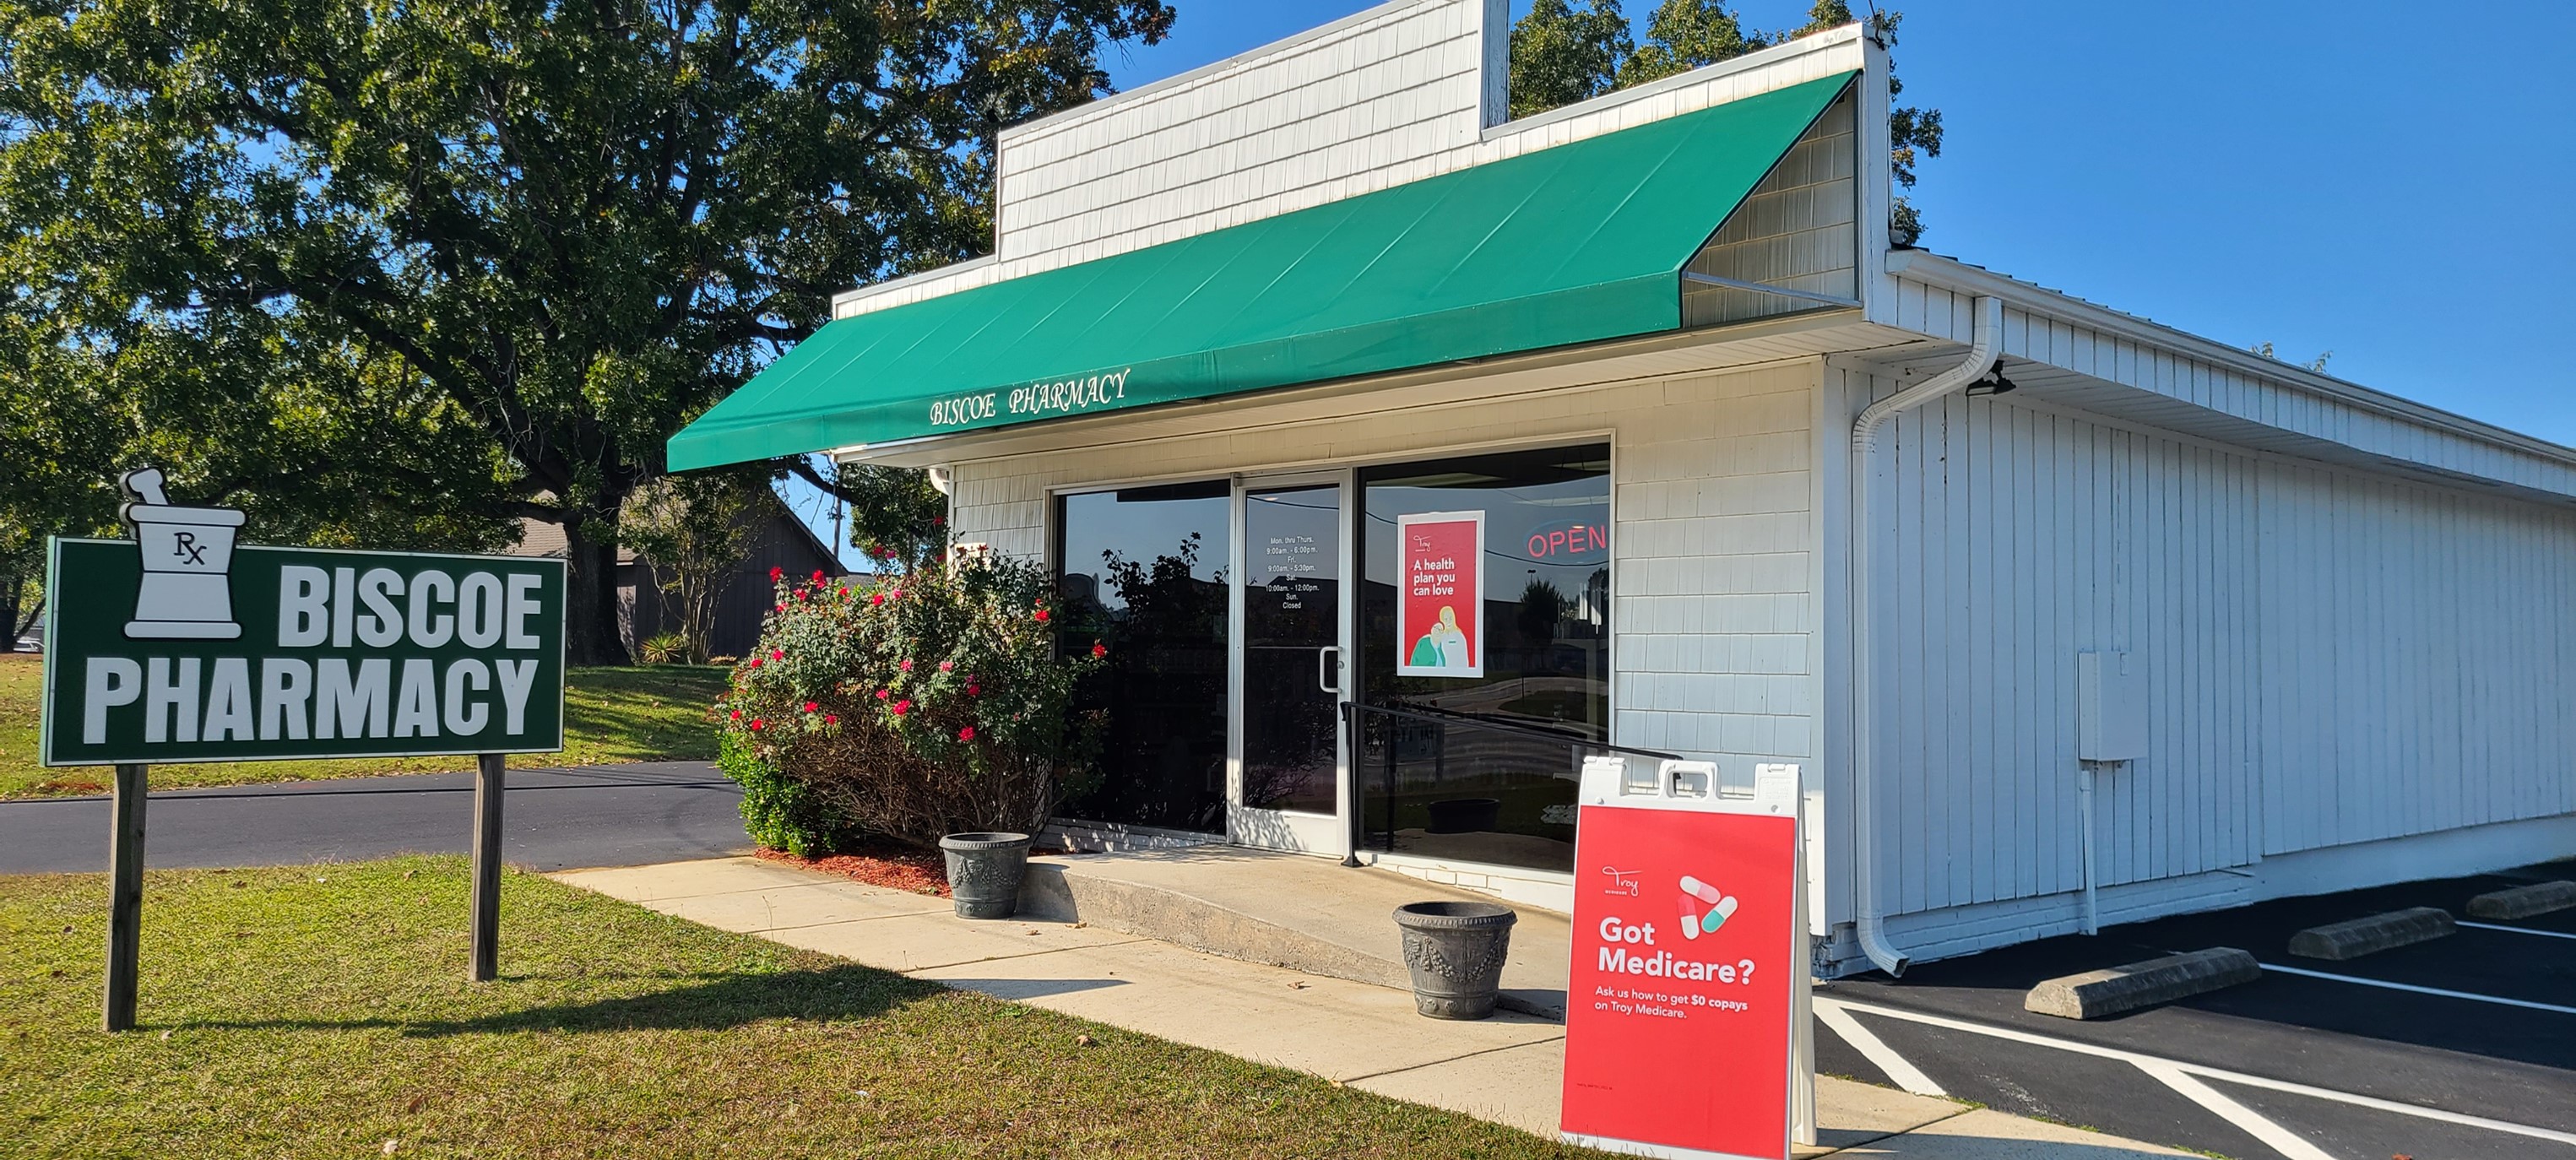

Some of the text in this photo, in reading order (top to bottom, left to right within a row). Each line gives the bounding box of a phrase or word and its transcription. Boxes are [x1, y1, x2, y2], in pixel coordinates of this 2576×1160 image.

[930, 368, 1131, 426] BISCOE PHARMACY
[1527, 525, 1607, 558] OPEN
[1413, 557, 1455, 571] A health
[1413, 572, 1456, 587] plan you
[1413, 583, 1454, 596] can love
[278, 565, 542, 650] BISCOE
[83, 657, 540, 745] PHARMACY
[1602, 865, 1644, 897] Troy
[1599, 916, 1656, 946] Got
[1597, 946, 1755, 985] Medicare?
[1594, 1000, 1688, 1020] on Troy Medicare.
[1595, 985, 1749, 1013] Ask us how to get $0 copays
